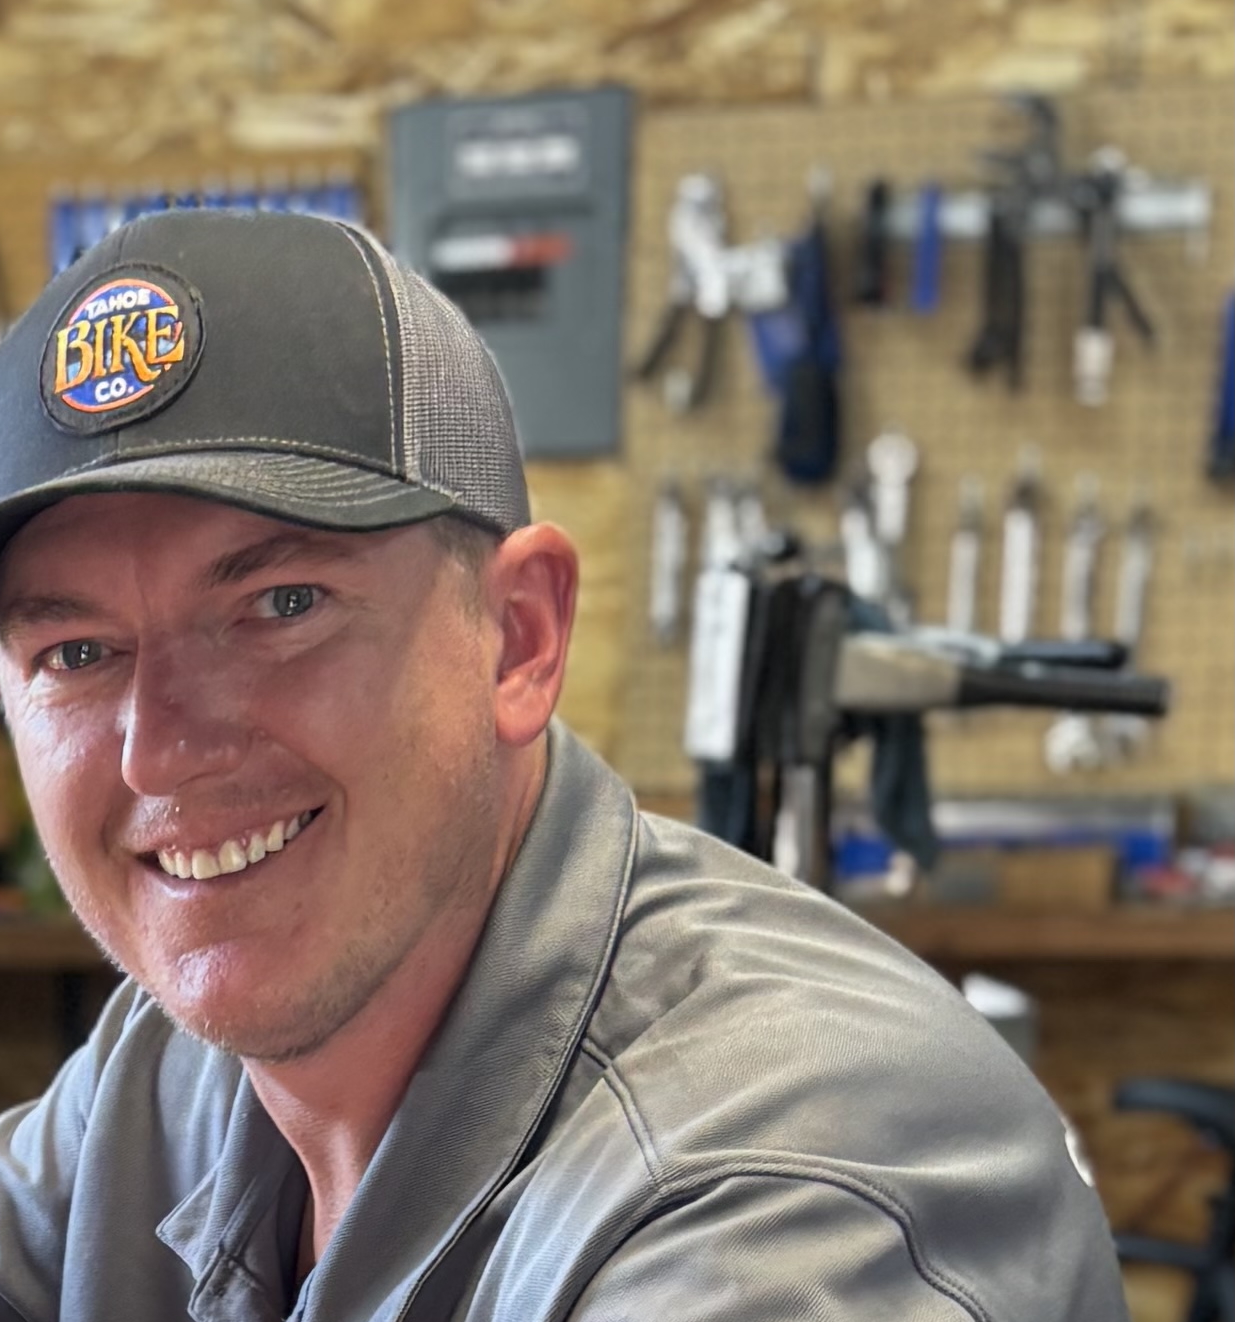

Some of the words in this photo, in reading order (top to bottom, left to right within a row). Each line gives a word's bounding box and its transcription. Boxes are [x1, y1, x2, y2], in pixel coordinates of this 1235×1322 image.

[85, 288, 152, 319] TAHOE
[54, 304, 185, 394] BIKE
[95, 376, 135, 403] CO.
